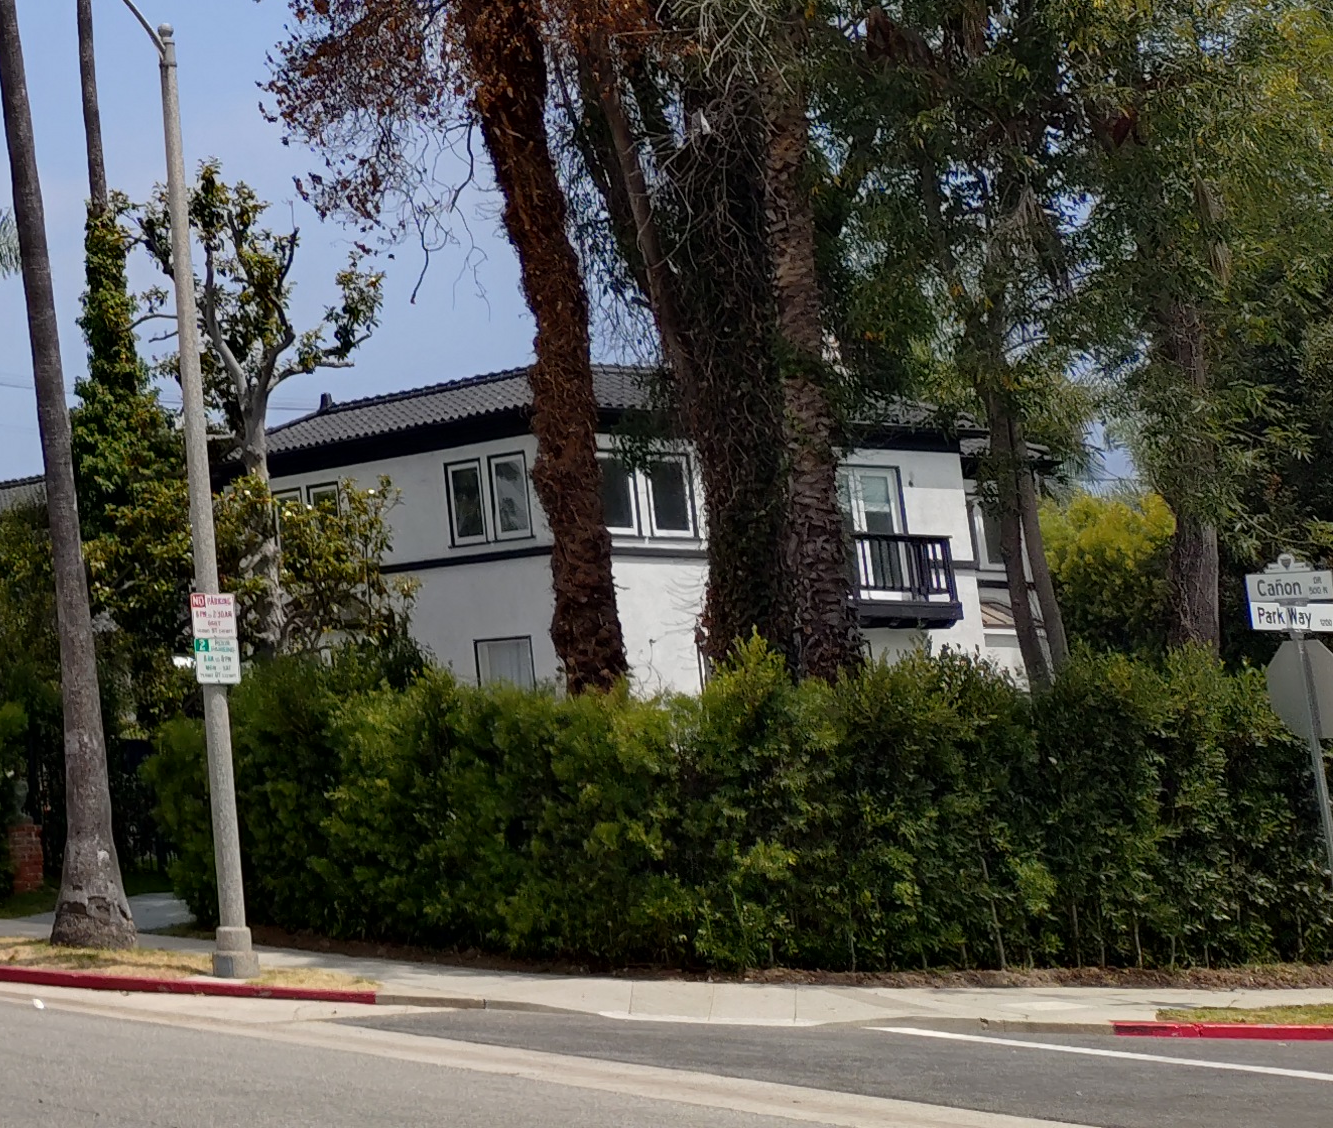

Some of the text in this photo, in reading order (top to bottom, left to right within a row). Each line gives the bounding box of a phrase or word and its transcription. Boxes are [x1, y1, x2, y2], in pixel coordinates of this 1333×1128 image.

[1257, 578, 1302, 596] Cañon
[193, 595, 232, 606] NO PARKING
[1257, 606, 1312, 629] Park Way
[198, 639, 206, 650] 2
